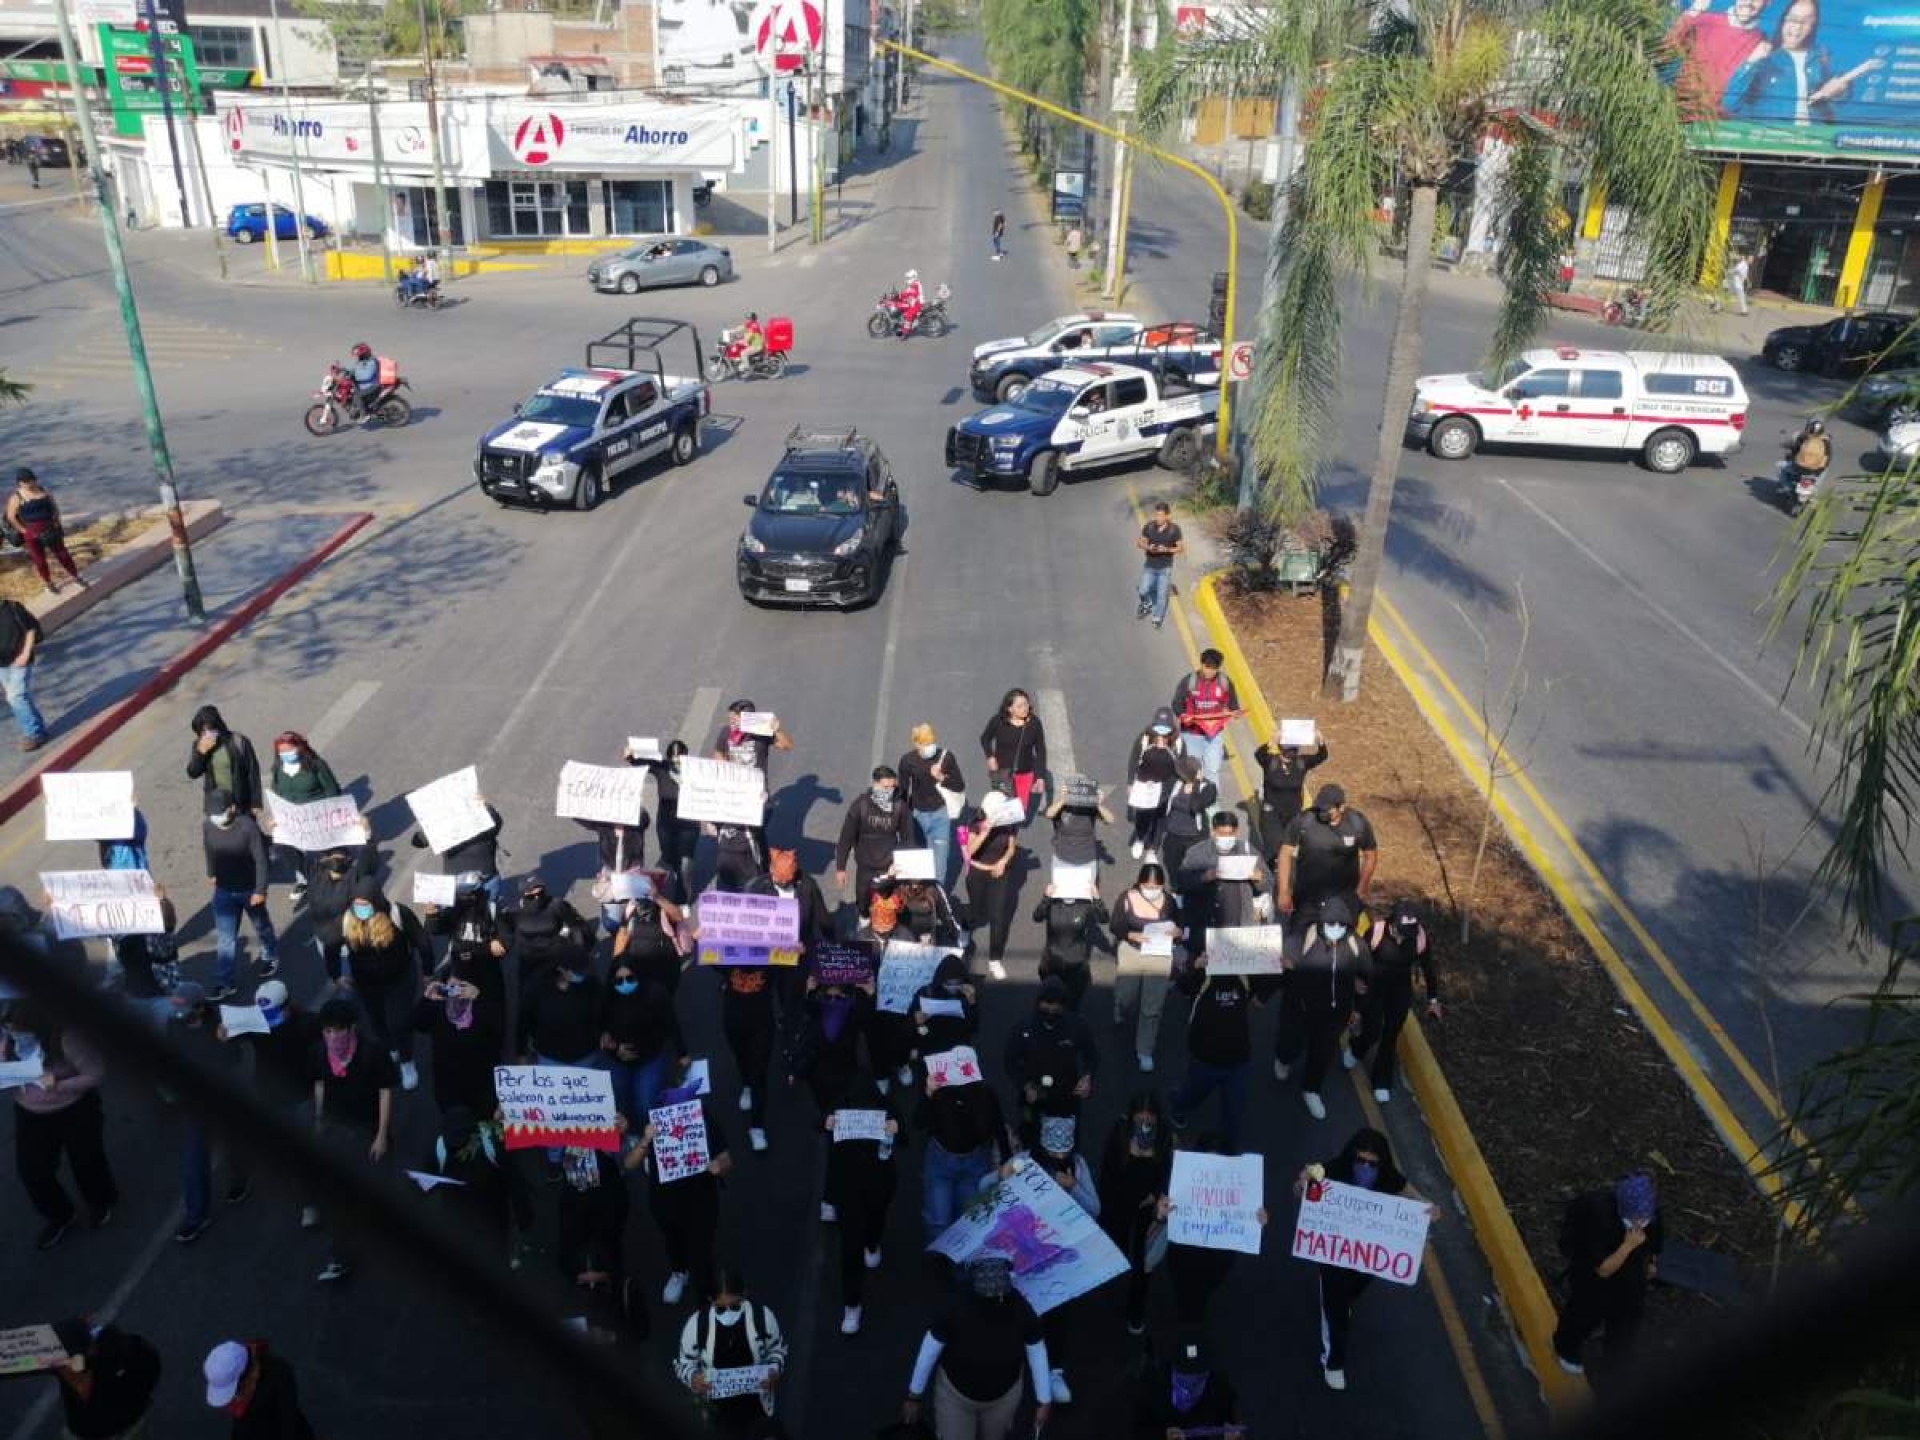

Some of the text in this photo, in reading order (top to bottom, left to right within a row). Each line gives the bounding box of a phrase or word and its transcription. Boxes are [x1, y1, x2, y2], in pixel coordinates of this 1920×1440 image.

[624, 124, 689, 145] Ahorro
[562, 1075, 589, 1090] que
[1296, 1228, 1412, 1280] MATANDO
